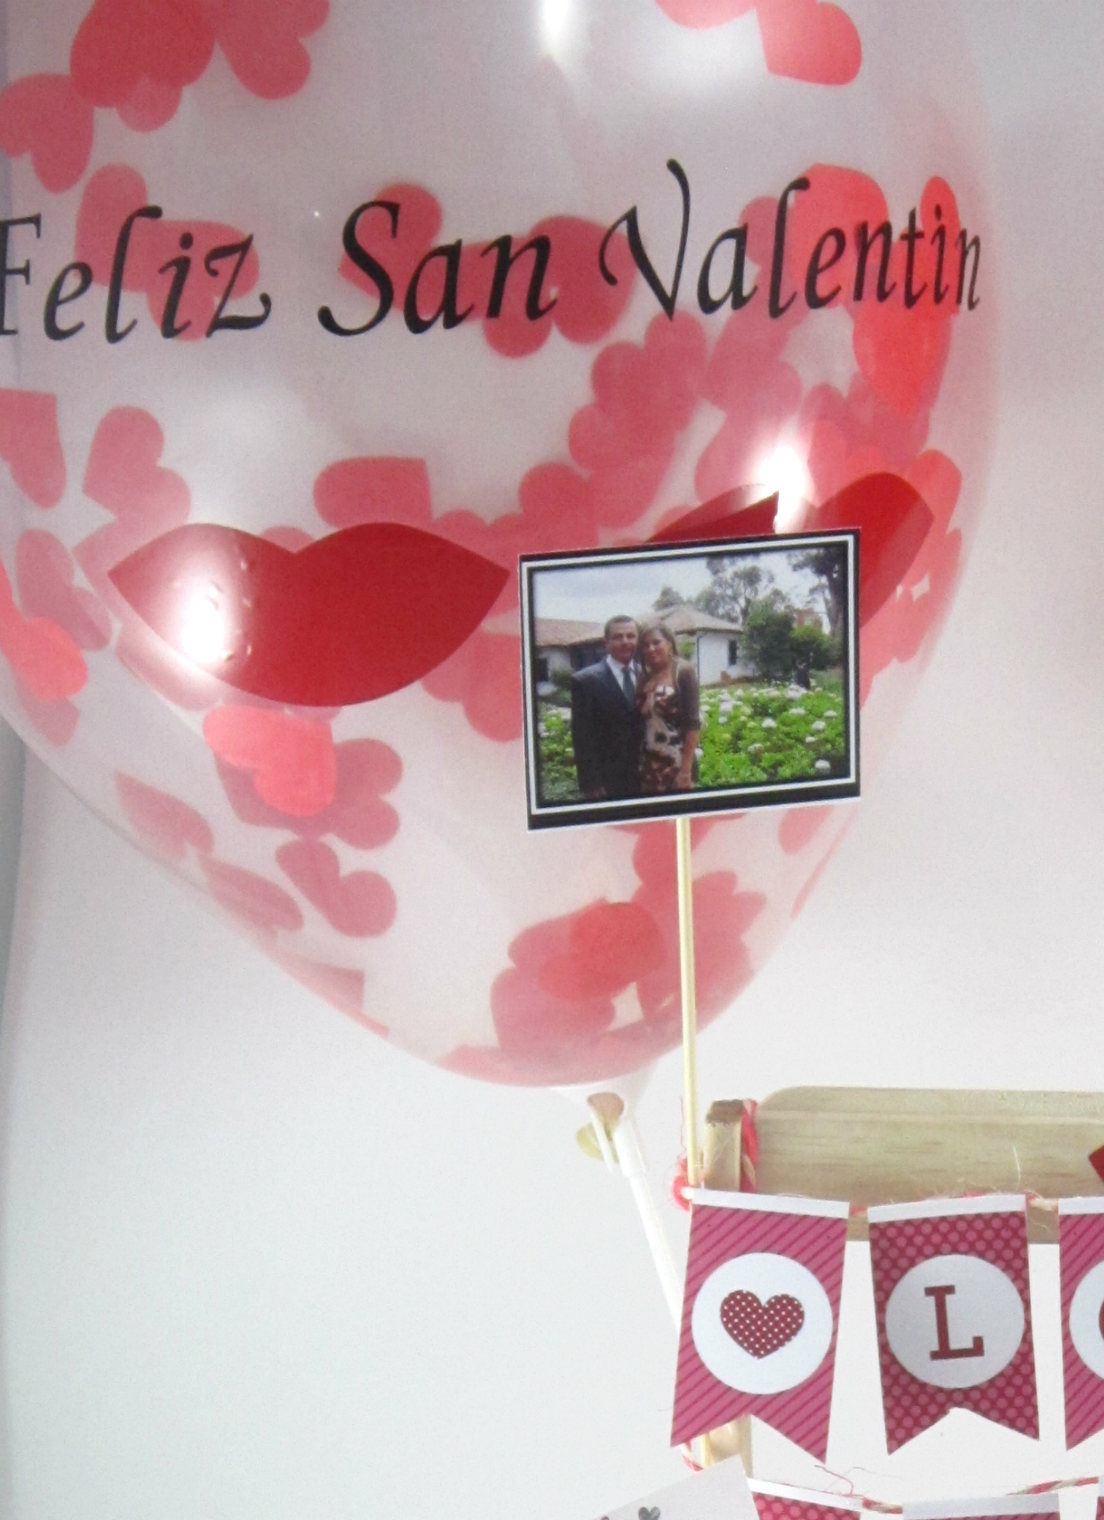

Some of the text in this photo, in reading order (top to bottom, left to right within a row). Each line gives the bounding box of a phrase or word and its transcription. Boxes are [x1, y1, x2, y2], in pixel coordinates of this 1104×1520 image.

[0, 157, 983, 345] Feliz San Valentin
